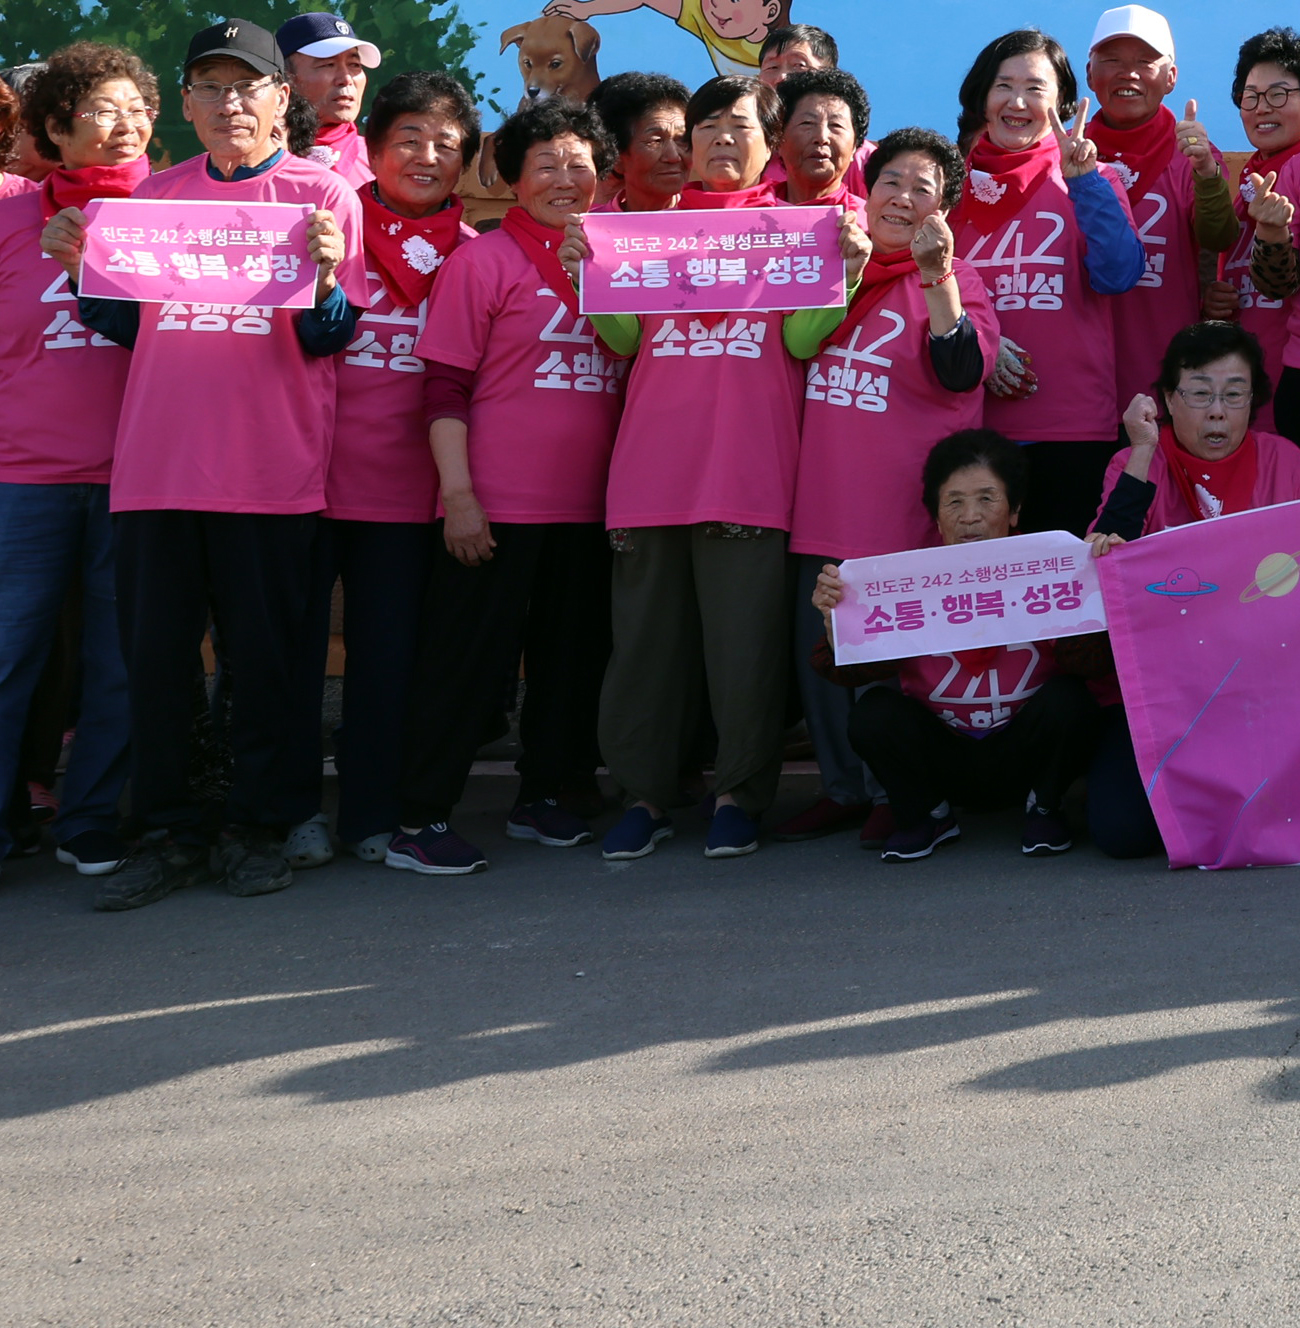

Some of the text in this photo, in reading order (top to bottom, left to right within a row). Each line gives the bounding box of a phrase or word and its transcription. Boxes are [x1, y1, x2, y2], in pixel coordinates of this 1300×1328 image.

[101, 227, 292, 247] 진도군 242 소행성프로젝트
[613, 232, 817, 253] 진도군 242 소행성프로젝트
[345, 330, 426, 373] 소행
[652, 318, 767, 359] 소행성
[806, 362, 890, 413] 소행성
[864, 556, 1076, 597] 진도군 242 소행성프로젝트
